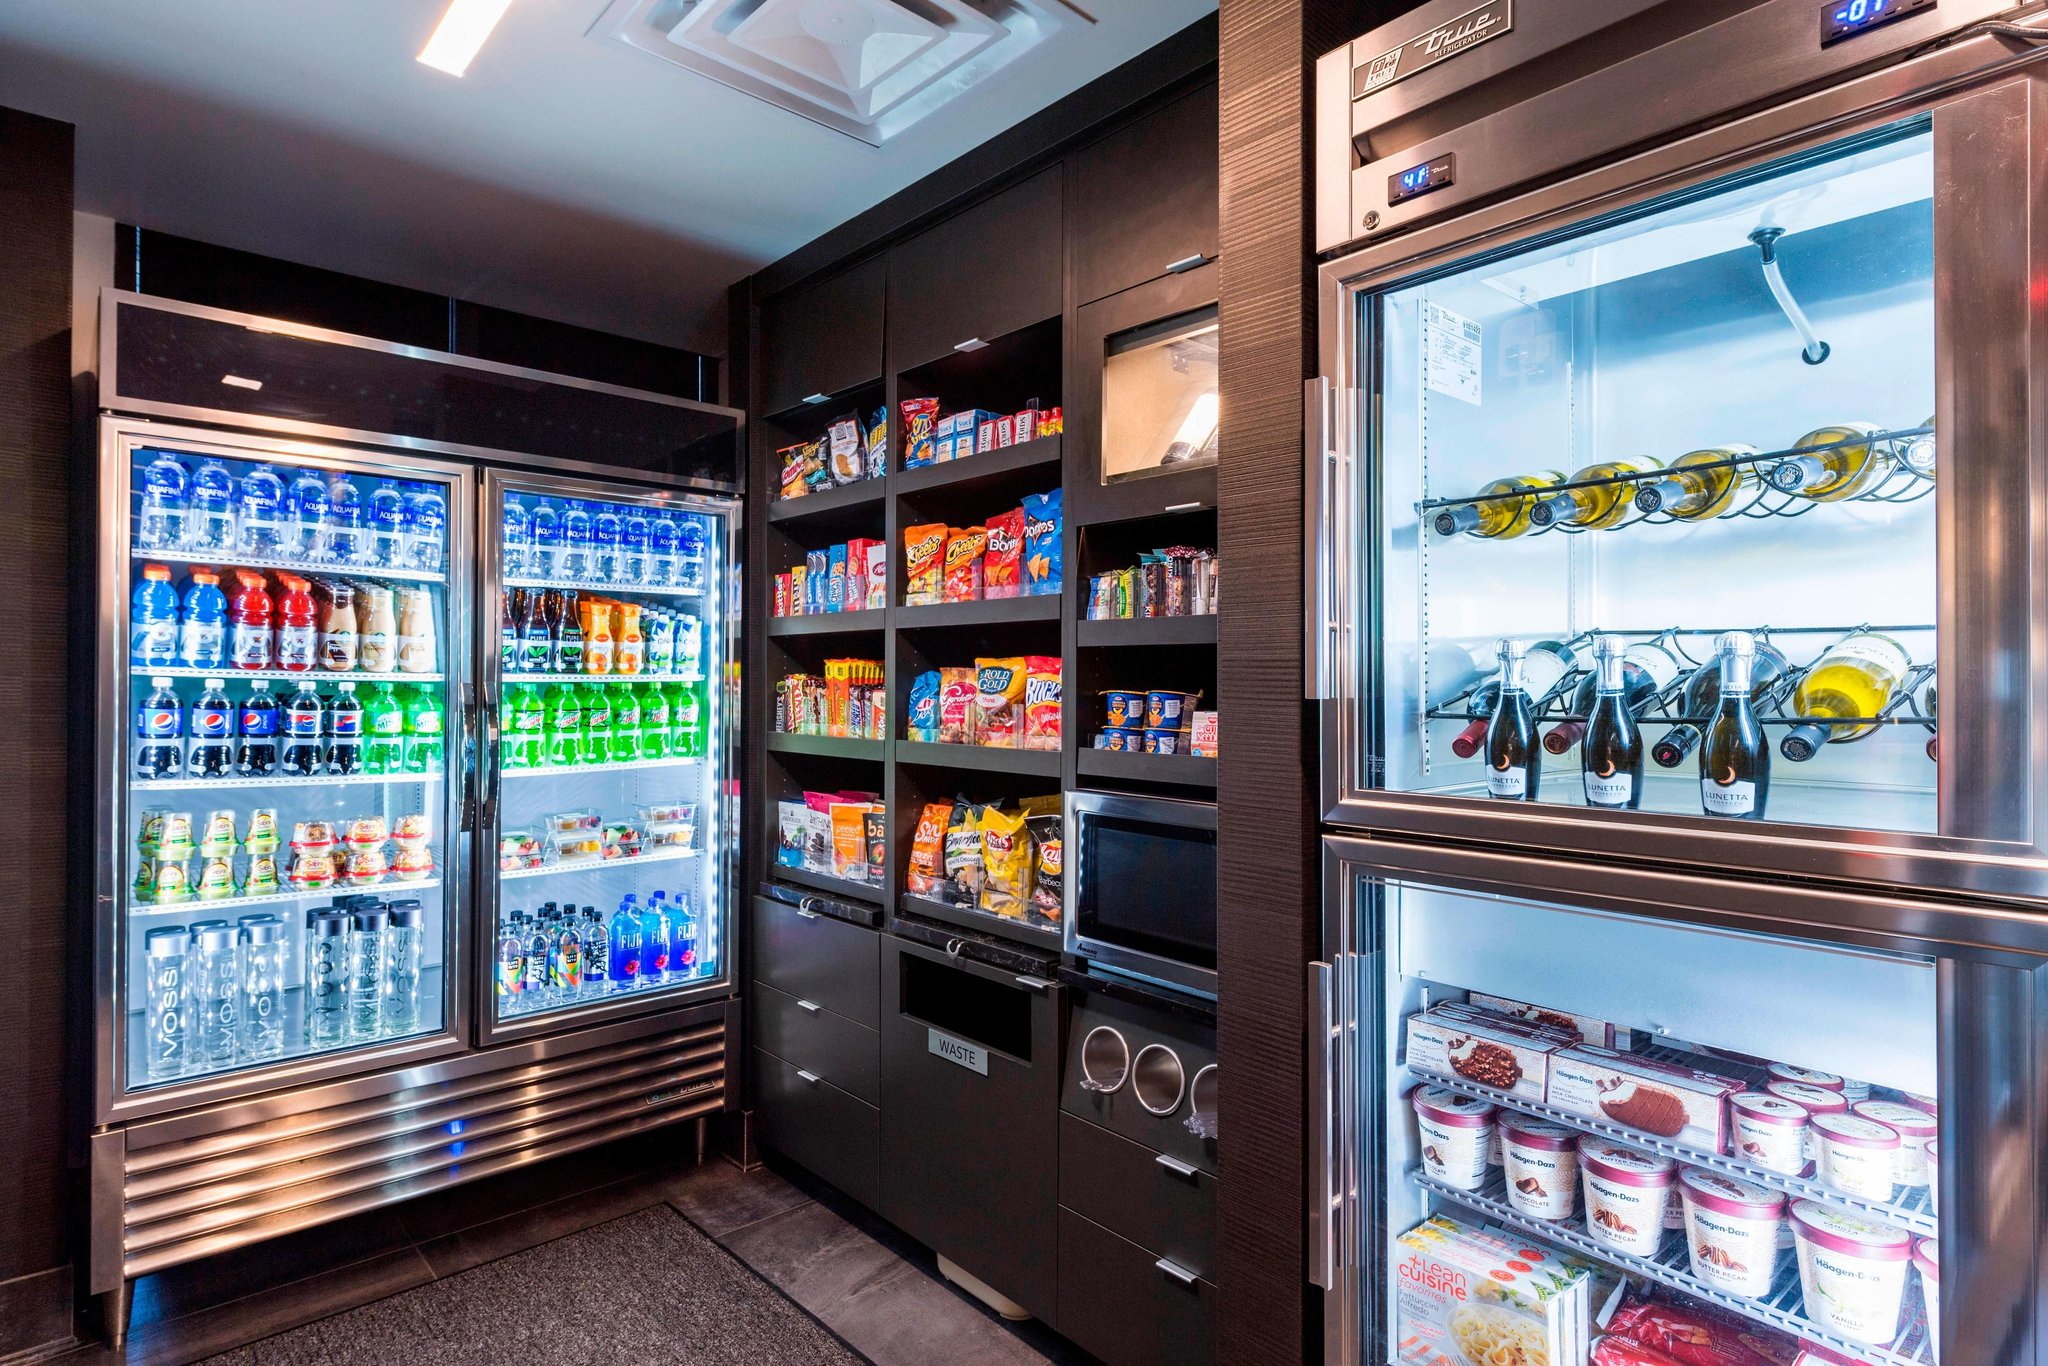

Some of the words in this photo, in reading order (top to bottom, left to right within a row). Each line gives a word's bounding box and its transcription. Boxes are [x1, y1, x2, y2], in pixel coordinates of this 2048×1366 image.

[1434, 29, 1488, 58] REFRIGERATOR
[984, 669, 1010, 680] ROLD
[979, 678, 1007, 691] GOLD
[1488, 776, 1521, 785] LUNETTA
[1588, 782, 1626, 792] LUNETTA
[1705, 790, 1749, 801] LUNETTA
[162, 966, 178, 1059] VOSS
[938, 1038, 976, 1066] WASTE
[1556, 1069, 1594, 1086] Häagen-Dazs
[1552, 1086, 1571, 1094] VANILLA
[1566, 1093, 1594, 1105] CHOCOLATE
[1509, 1150, 1556, 1169] Häagen-Dazs
[1515, 1192, 1550, 1207] CHOCOLATE
[1590, 1180, 1640, 1203] Häagen-Dazs
[1592, 1222, 1612, 1236] BUTTER
[1614, 1232, 1637, 1243] PECAN
[1694, 1212, 1750, 1238] Häagen-Dazs
[1422, 1258, 1466, 1288] Lean
[1697, 1259, 1720, 1275] BUTTER
[1722, 1270, 1747, 1282] PECAN
[1400, 1288, 1439, 1313] Fettuccini
[1400, 1298, 1430, 1317] Alfredo
